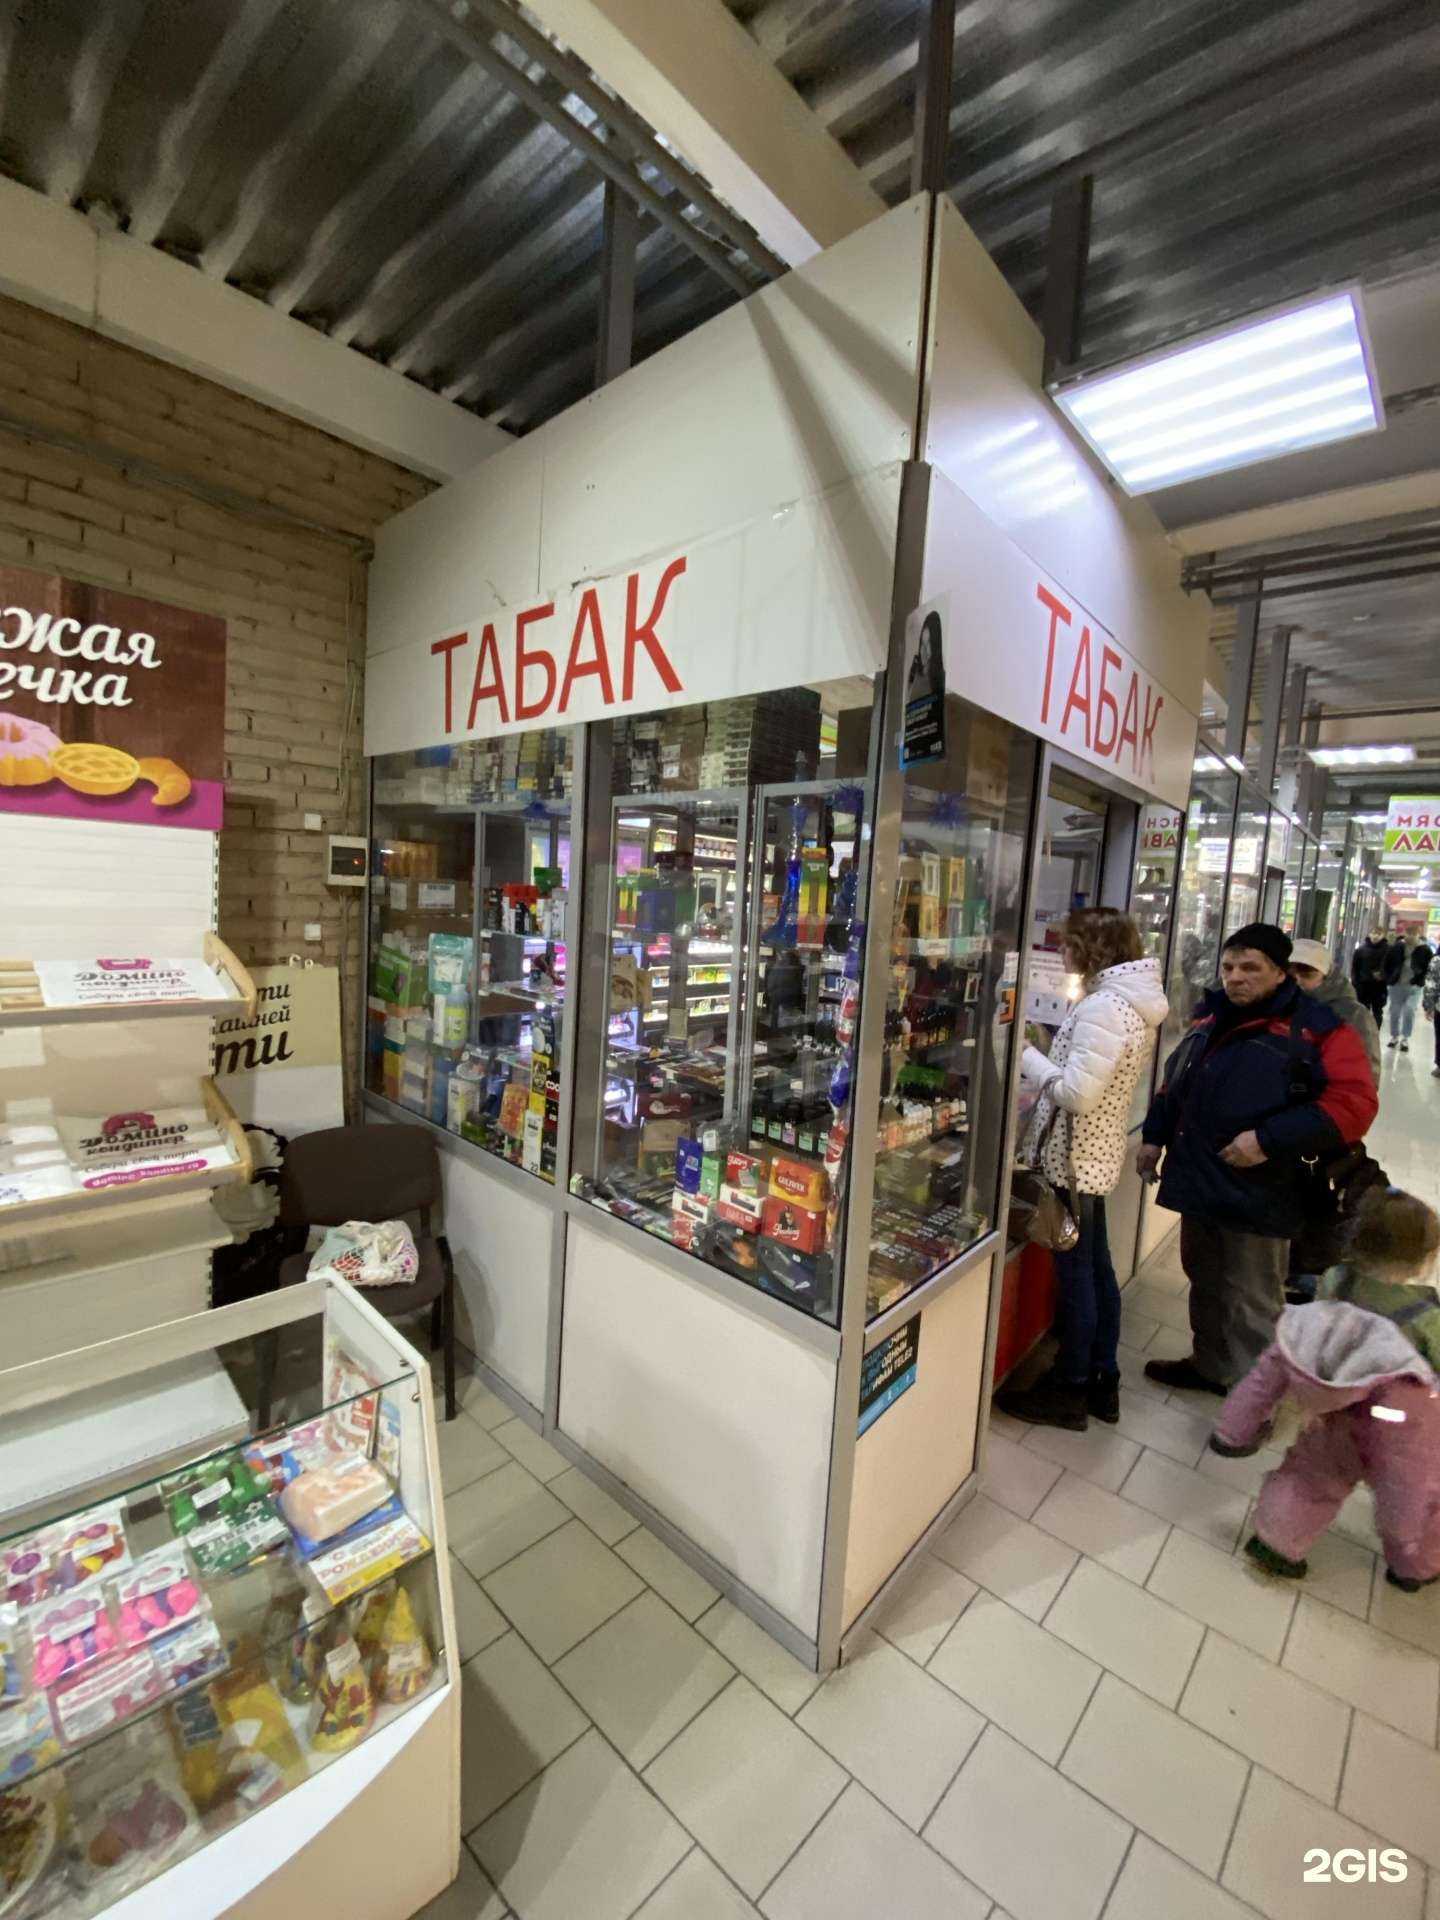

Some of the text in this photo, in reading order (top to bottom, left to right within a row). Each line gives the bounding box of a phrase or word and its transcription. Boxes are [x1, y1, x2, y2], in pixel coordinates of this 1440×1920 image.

[431, 556, 687, 734] ТАБАК
[1036, 582, 1164, 785] ТАБАК
[1393, 833, 1440, 851] ЛА
[80, 1124, 189, 1149] Домино
